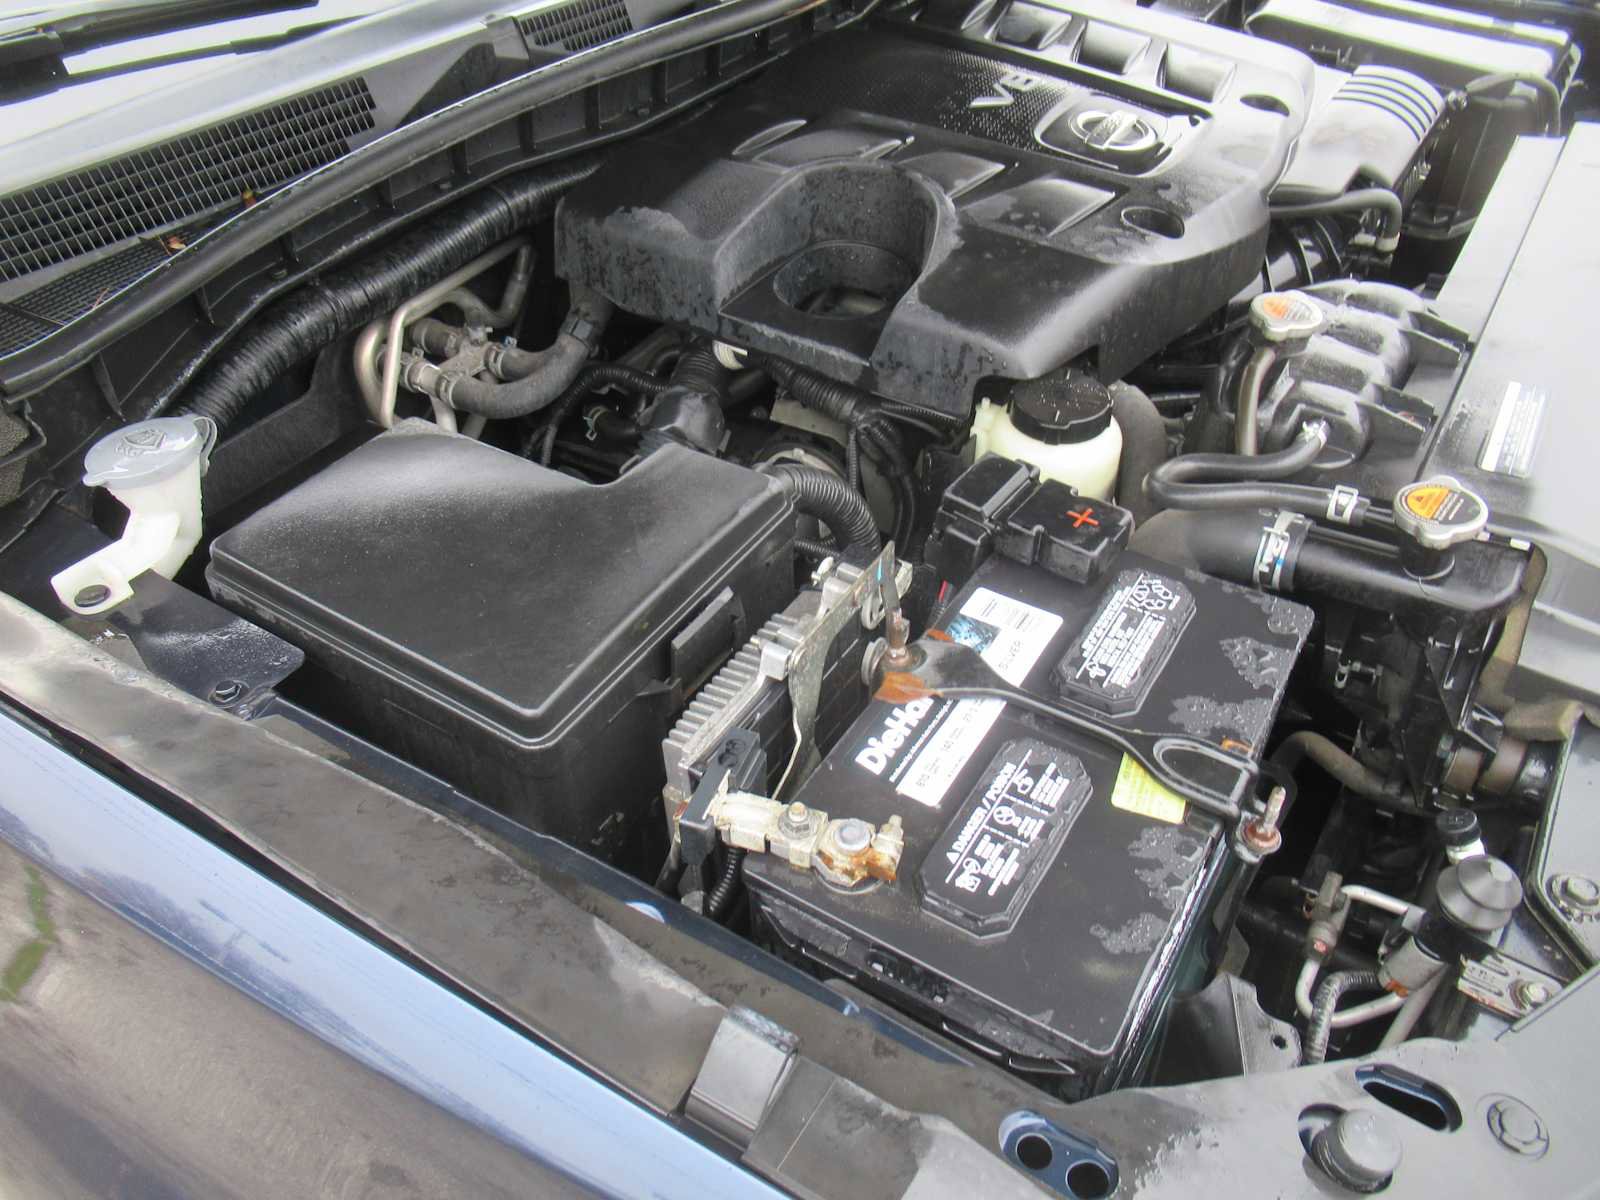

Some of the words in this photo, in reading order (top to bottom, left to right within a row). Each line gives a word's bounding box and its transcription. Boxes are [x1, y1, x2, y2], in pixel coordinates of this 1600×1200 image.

[854, 697, 935, 776] DieHa
[951, 806, 987, 852] DANGER
[985, 762, 1017, 801] POISON
